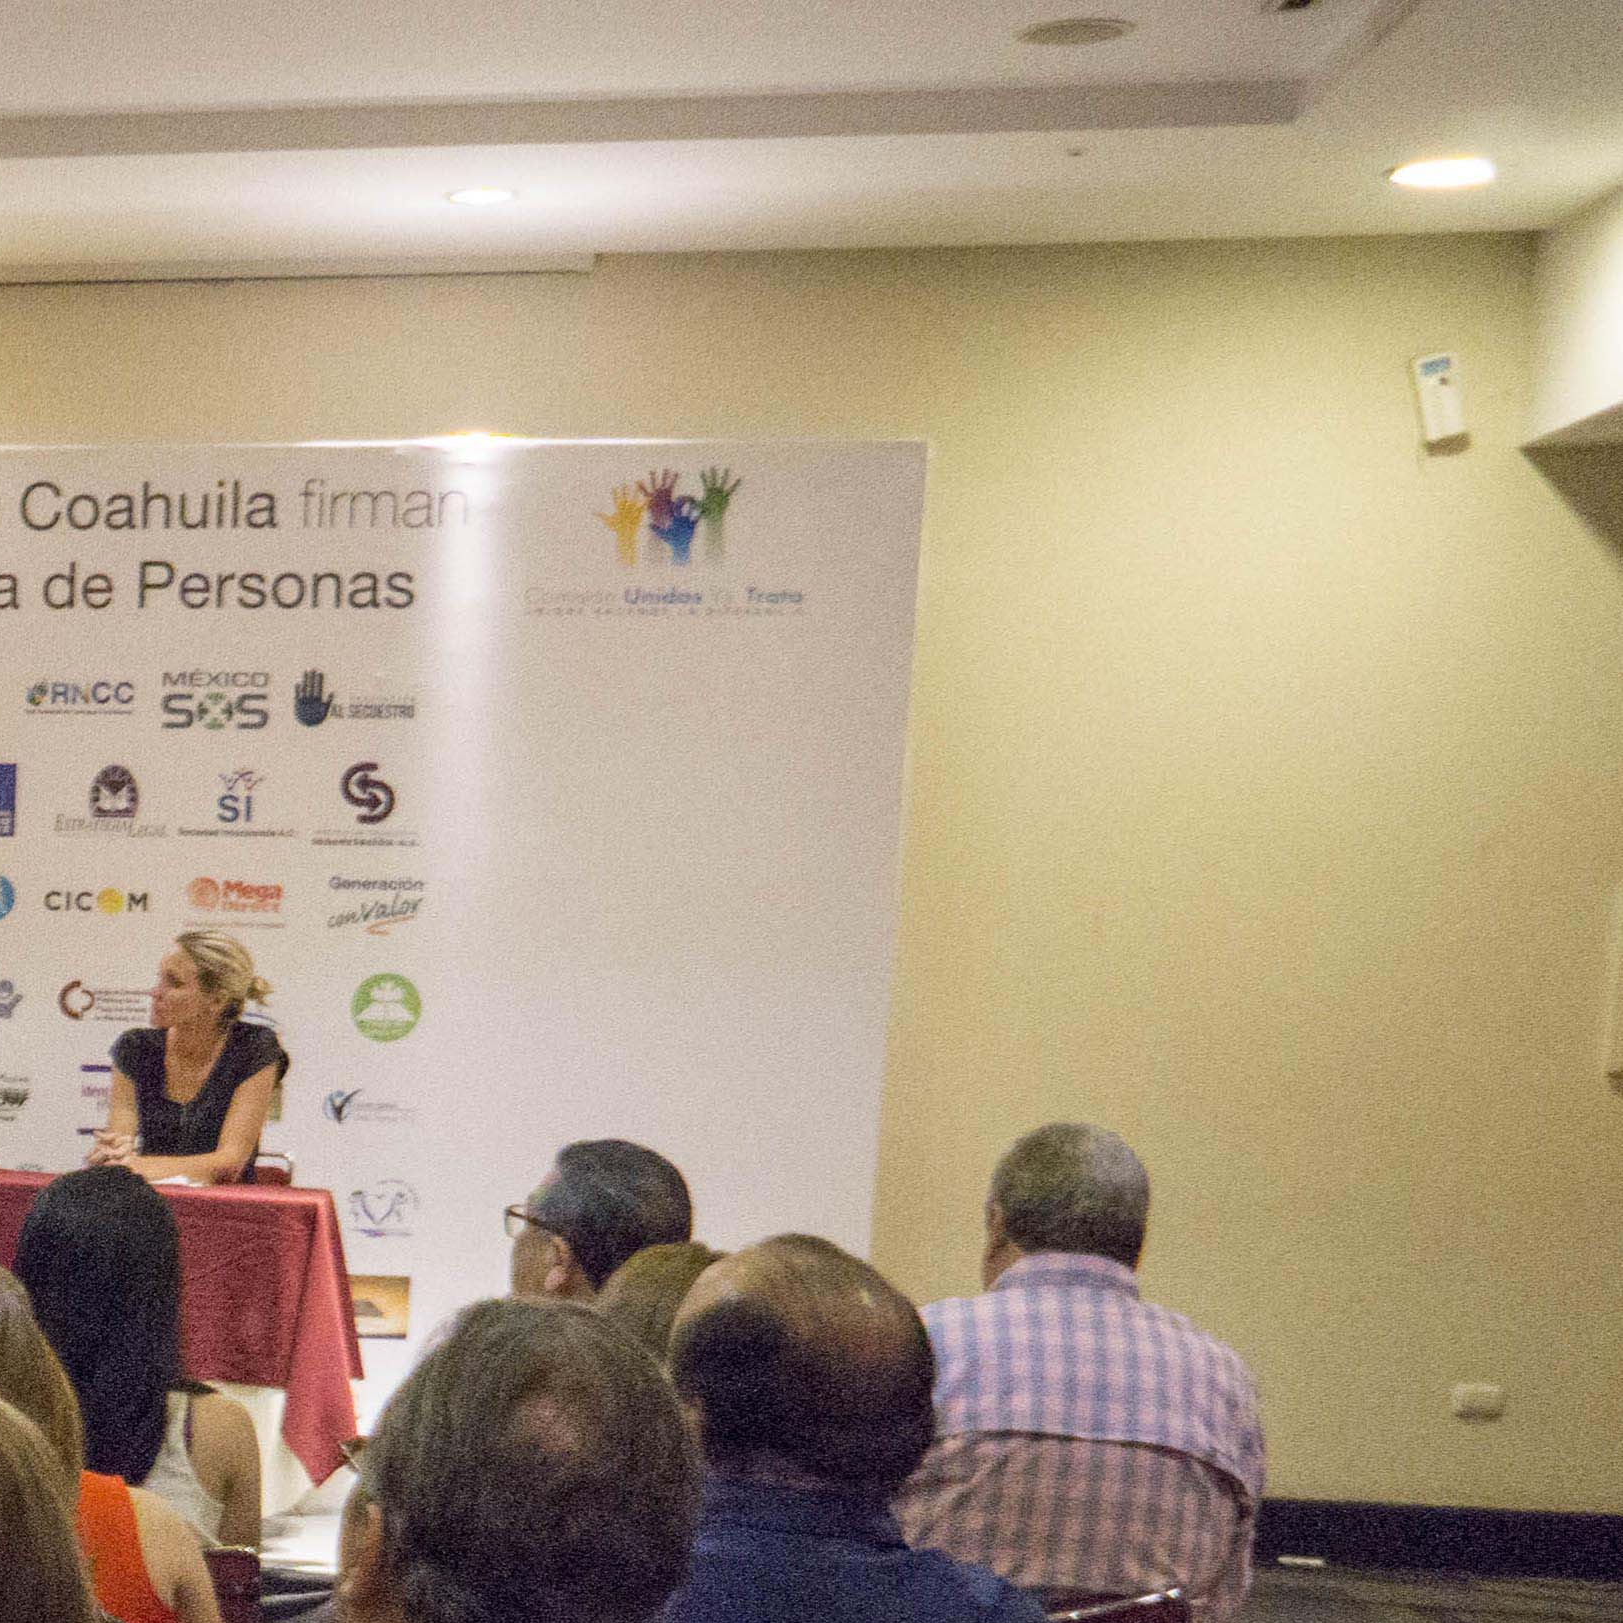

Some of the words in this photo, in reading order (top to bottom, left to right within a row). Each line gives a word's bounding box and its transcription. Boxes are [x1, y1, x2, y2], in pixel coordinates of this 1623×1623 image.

[20, 477, 277, 533] Coahuila
[297, 477, 468, 530] firman
[42, 562, 113, 610] de
[136, 560, 415, 610] Personas
[162, 669, 270, 688] MÉXICO
[50, 680, 135, 705] RNCC
[216, 794, 253, 823] SI
[329, 874, 425, 891] Generación
